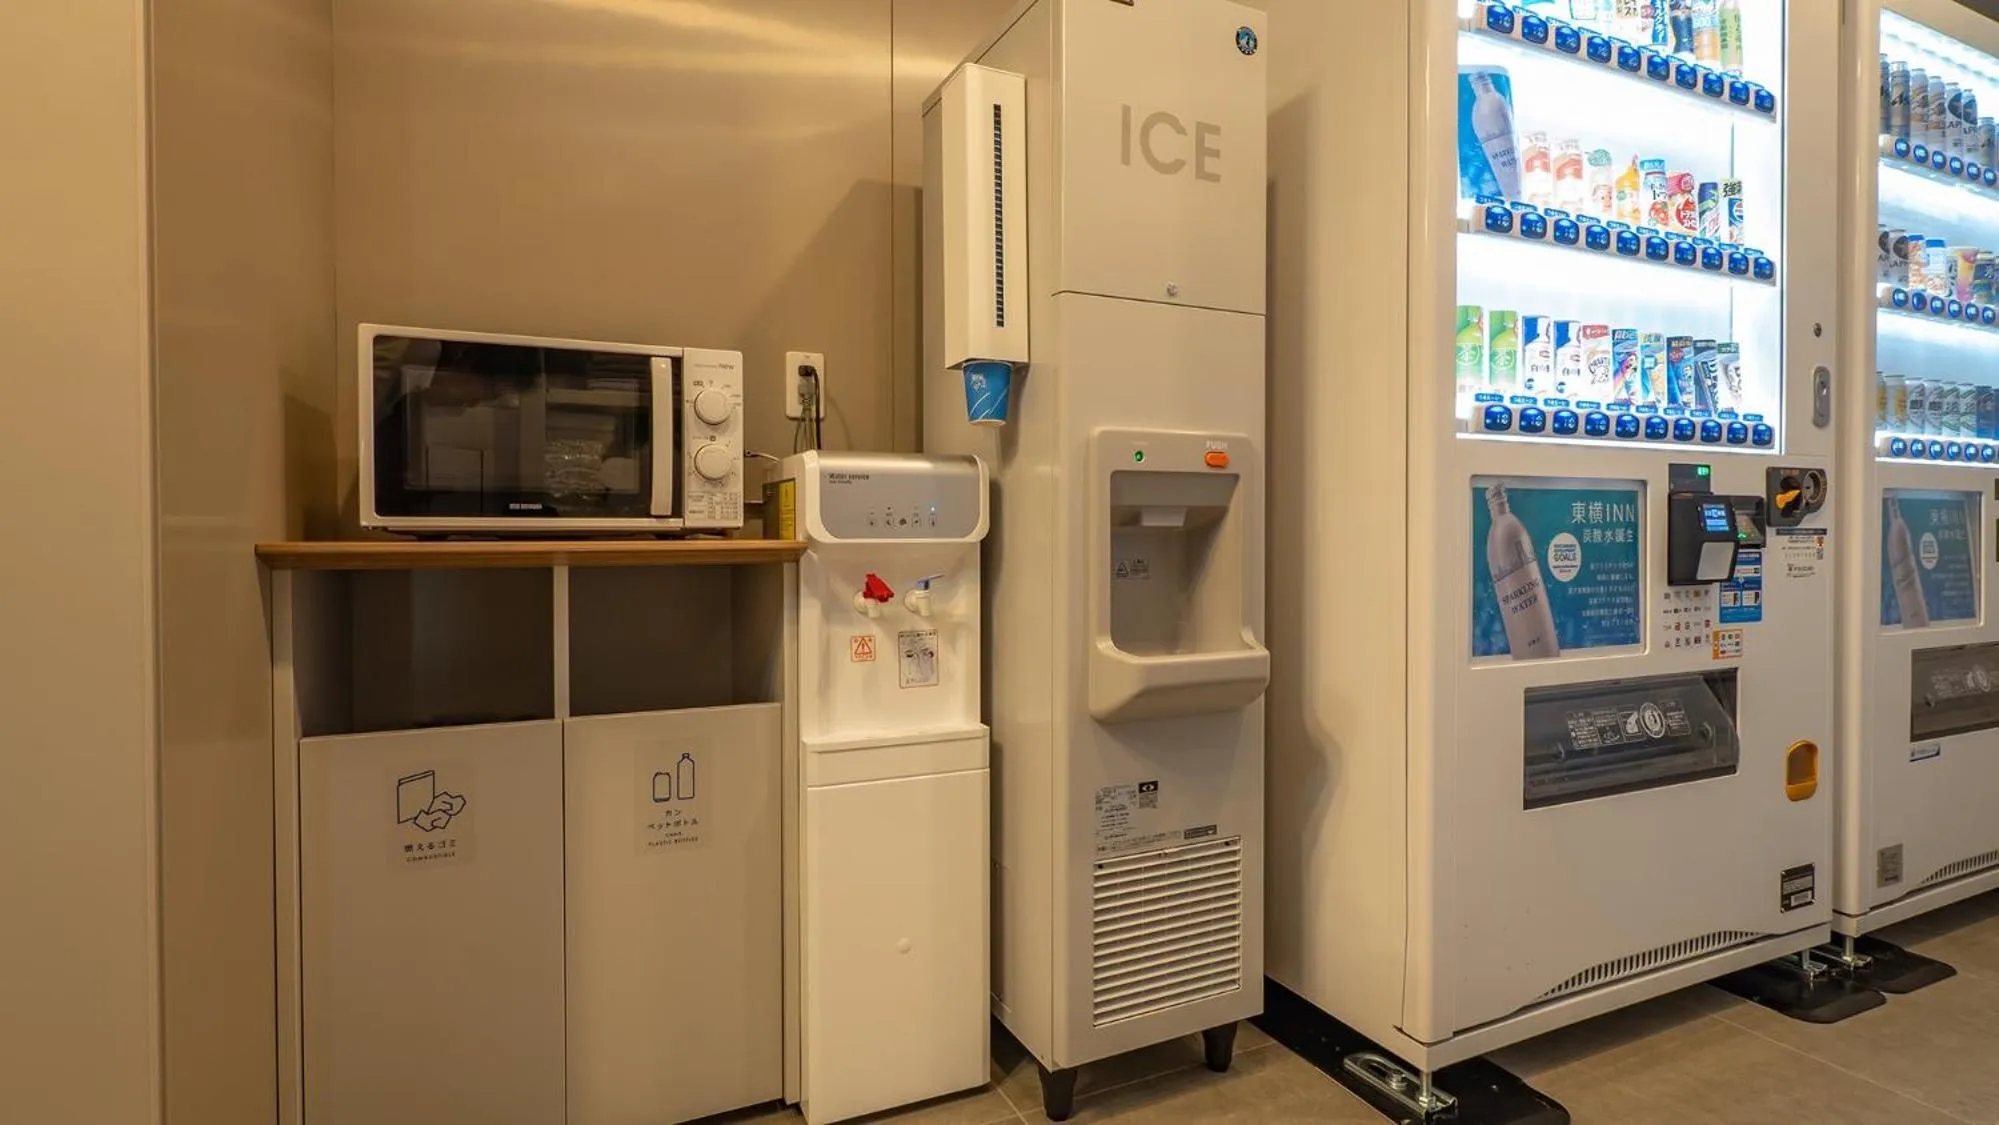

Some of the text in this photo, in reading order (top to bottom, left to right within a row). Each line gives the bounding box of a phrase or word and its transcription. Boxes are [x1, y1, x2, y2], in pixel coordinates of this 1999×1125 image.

[1121, 103, 1221, 184] ICE
[1205, 440, 1228, 450] PUSH
[1571, 501, 1635, 525] 東横INN
[1582, 527, 1634, 544] 炭酸水誕生
[1553, 551, 1577, 562] GOALS
[1502, 578, 1541, 606] SPARKLING
[1511, 594, 1538, 614] WATER
[404, 839, 456, 853] 燃えるゴミ
